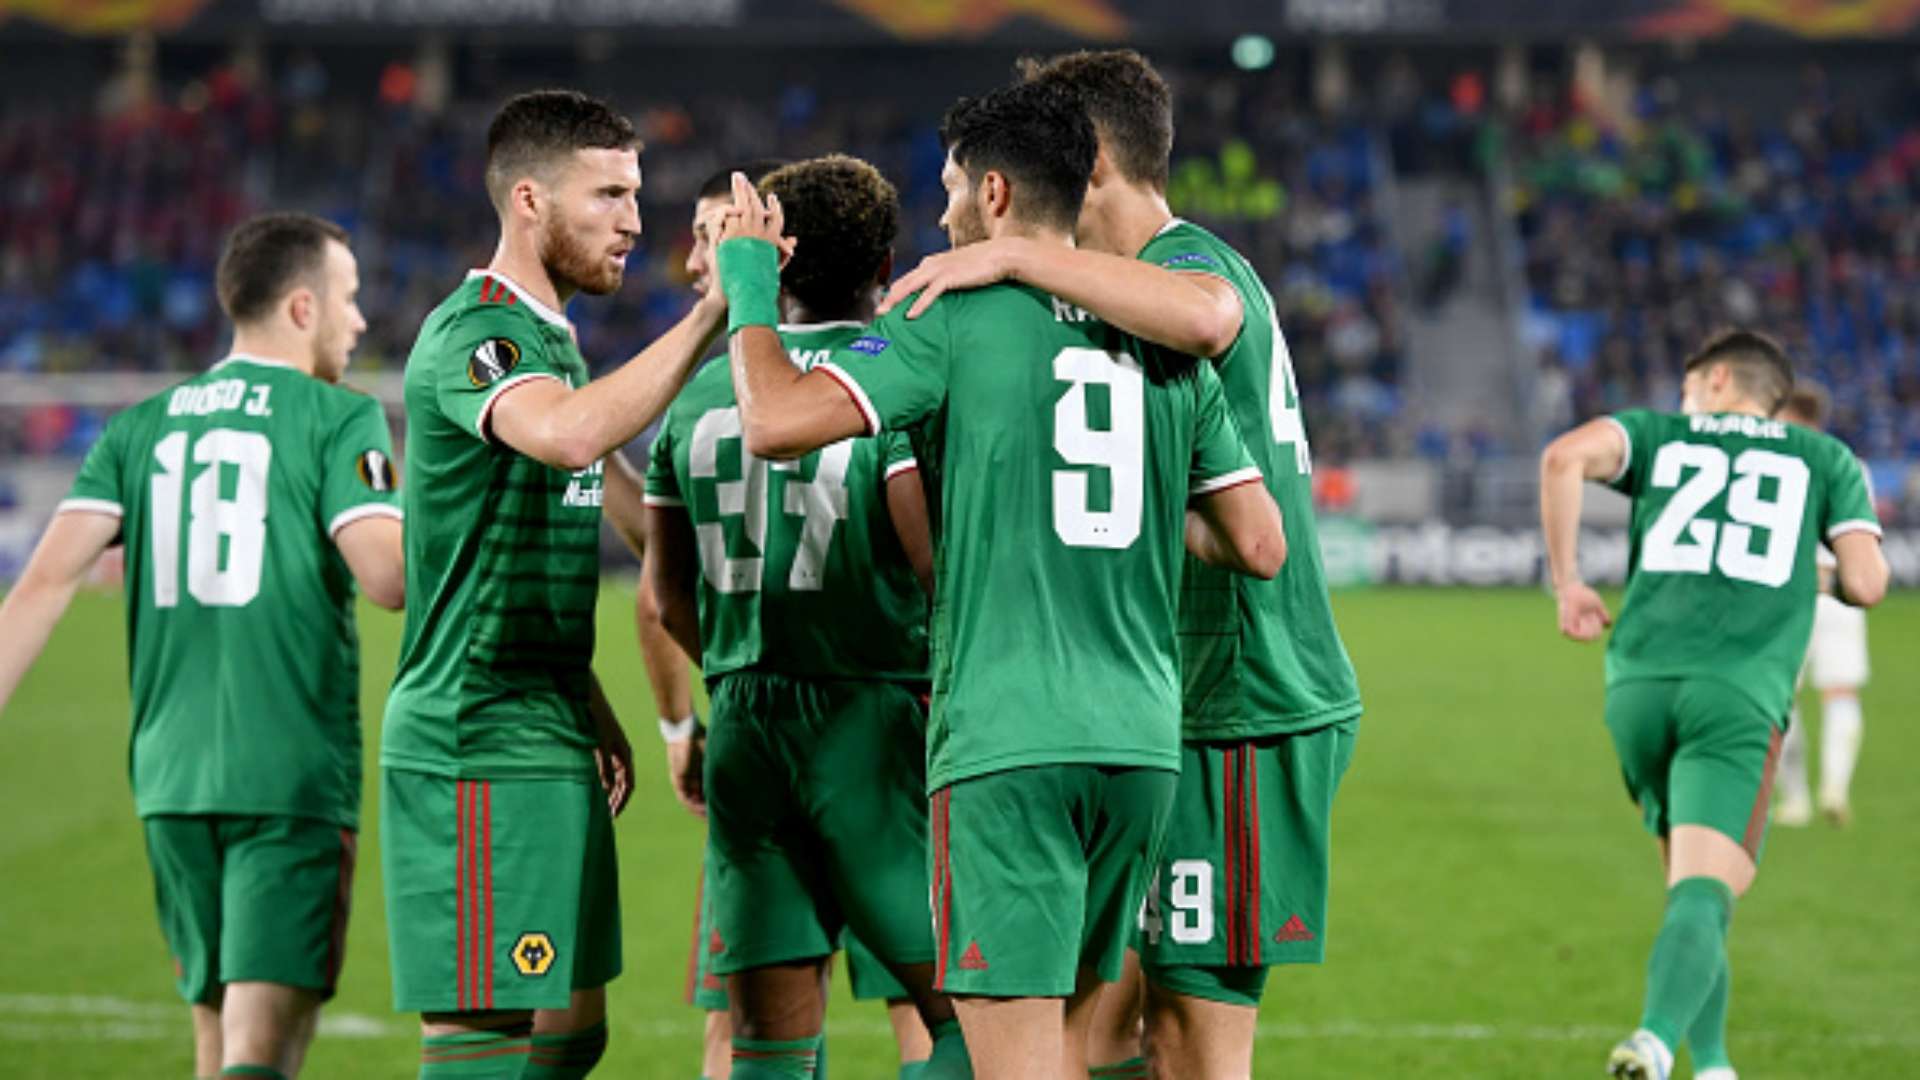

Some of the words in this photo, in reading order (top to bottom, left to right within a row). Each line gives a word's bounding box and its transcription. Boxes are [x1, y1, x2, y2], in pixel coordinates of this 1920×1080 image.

[168, 379, 246, 416] DIOGO
[245, 385, 273, 416] J.
[1052, 347, 1144, 549] 9
[150, 429, 272, 608] 18
[689, 406, 855, 594] 37
[1641, 441, 1811, 588] 29
